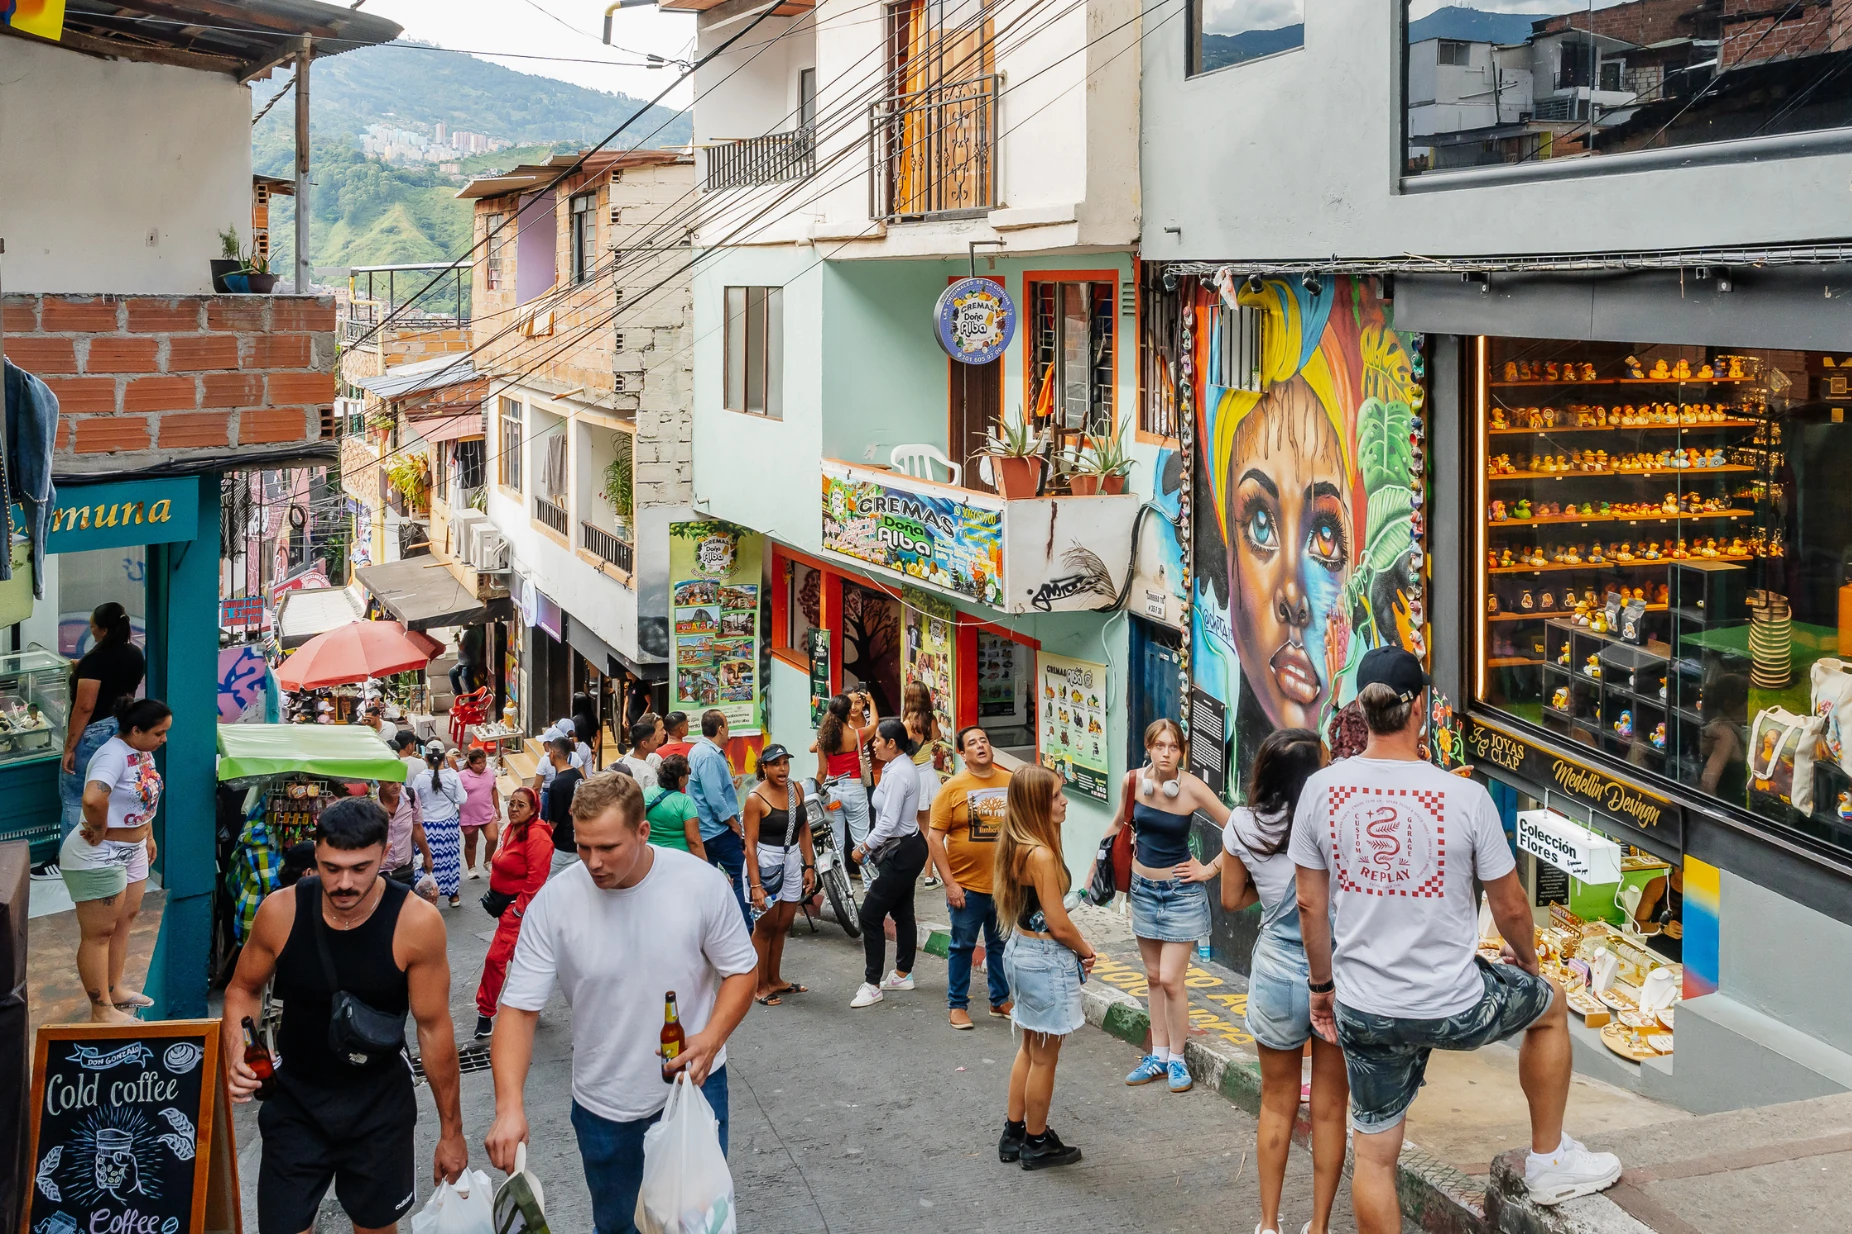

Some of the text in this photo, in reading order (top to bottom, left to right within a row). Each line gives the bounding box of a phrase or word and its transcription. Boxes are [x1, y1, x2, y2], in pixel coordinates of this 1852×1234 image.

[994, 284, 1010, 306] COMUNA
[960, 302, 994, 313] CREMAS
[964, 313, 984, 322] Doña
[960, 321, 987, 337] Alba
[858, 497, 954, 538] CREMAS
[885, 516, 923, 536] Doña
[877, 526, 931, 557] Alba
[703, 552, 724, 563] Alba
[682, 618, 719, 631] GUATAPÉ
[1491, 734, 1524, 760] JOYAS
[1491, 748, 1520, 771] CLAP
[1604, 782, 1661, 828] Desingn
[1520, 818, 1576, 859] Colección
[1520, 834, 1558, 863] Flores
[1360, 866, 1410, 883] REPLAY
[47, 1071, 179, 1116] Cold coffee
[90, 1208, 160, 1234] Coffee
